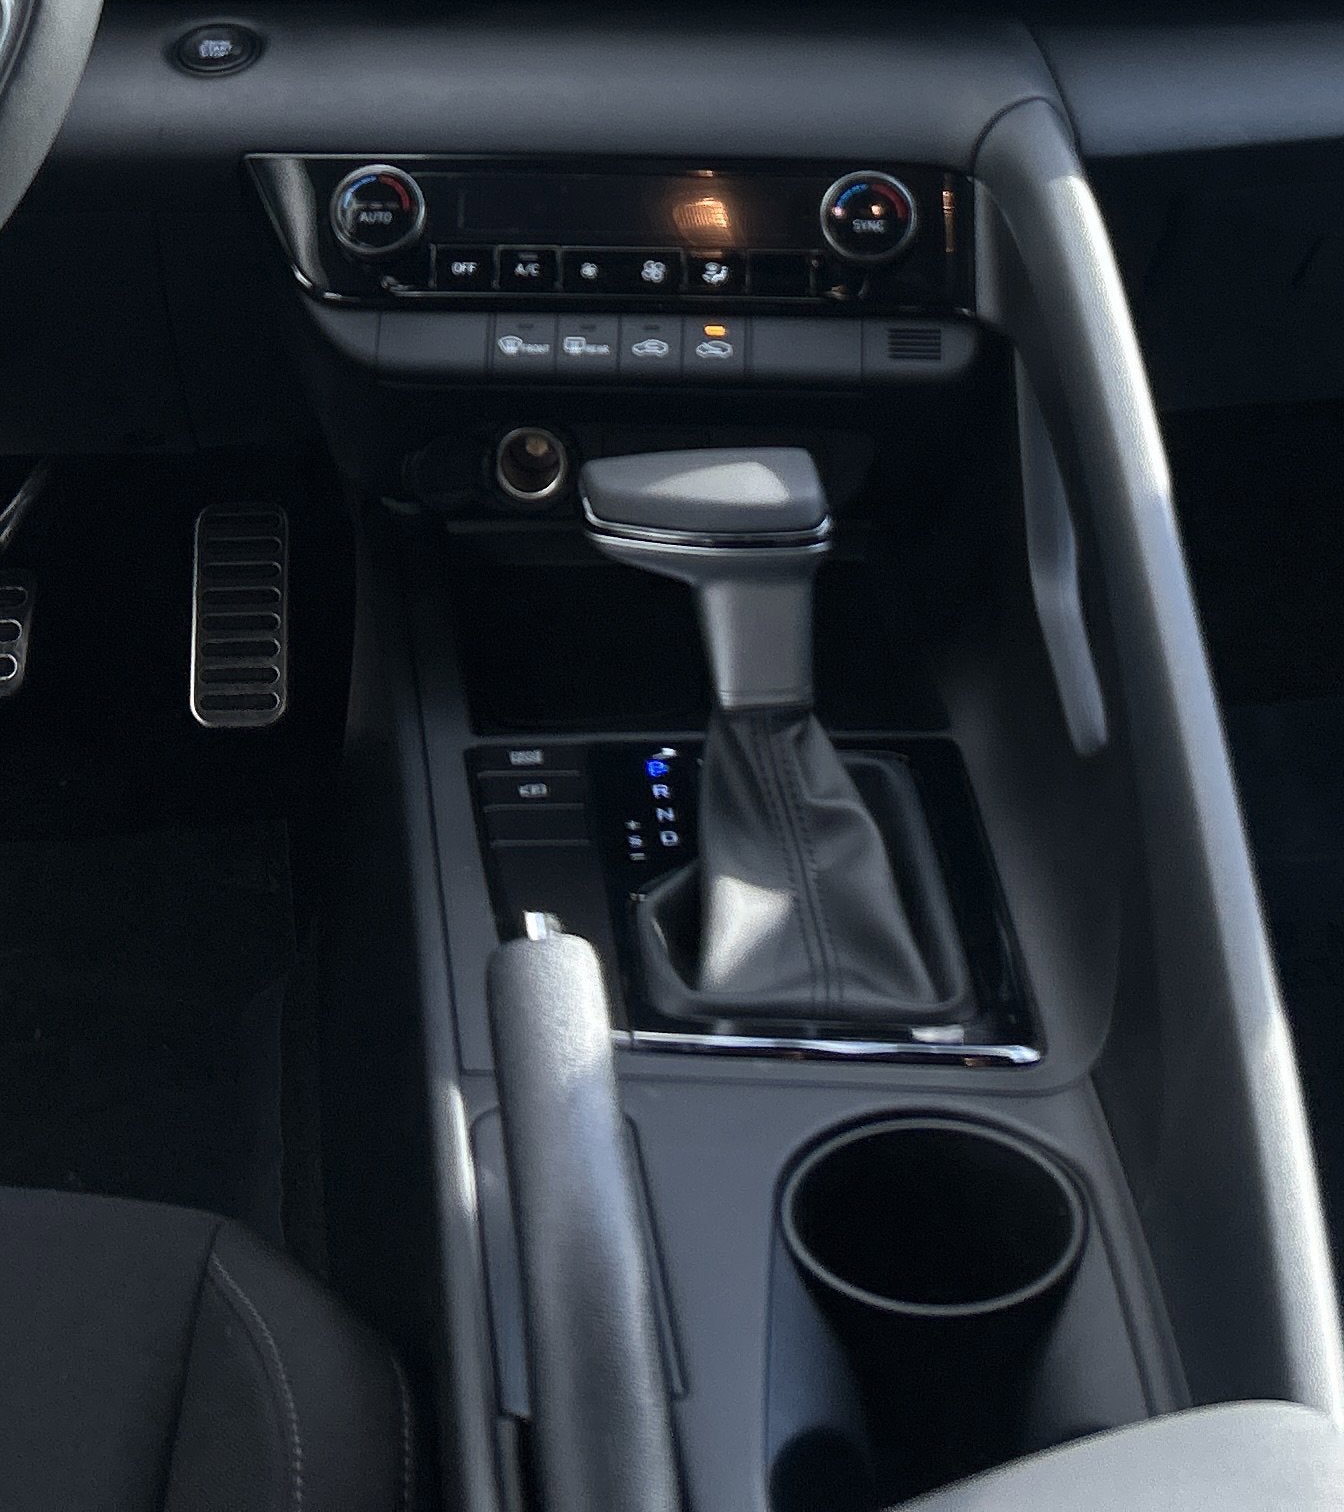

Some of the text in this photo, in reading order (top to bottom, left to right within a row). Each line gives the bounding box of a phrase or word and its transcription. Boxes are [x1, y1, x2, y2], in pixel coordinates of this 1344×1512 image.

[359, 211, 393, 225] AUTO
[852, 218, 886, 233] SYNC
[451, 261, 478, 275] OFF
[513, 262, 542, 277] A/C
[651, 783, 671, 800] R
[655, 806, 676, 823] N
[659, 830, 680, 847] D
